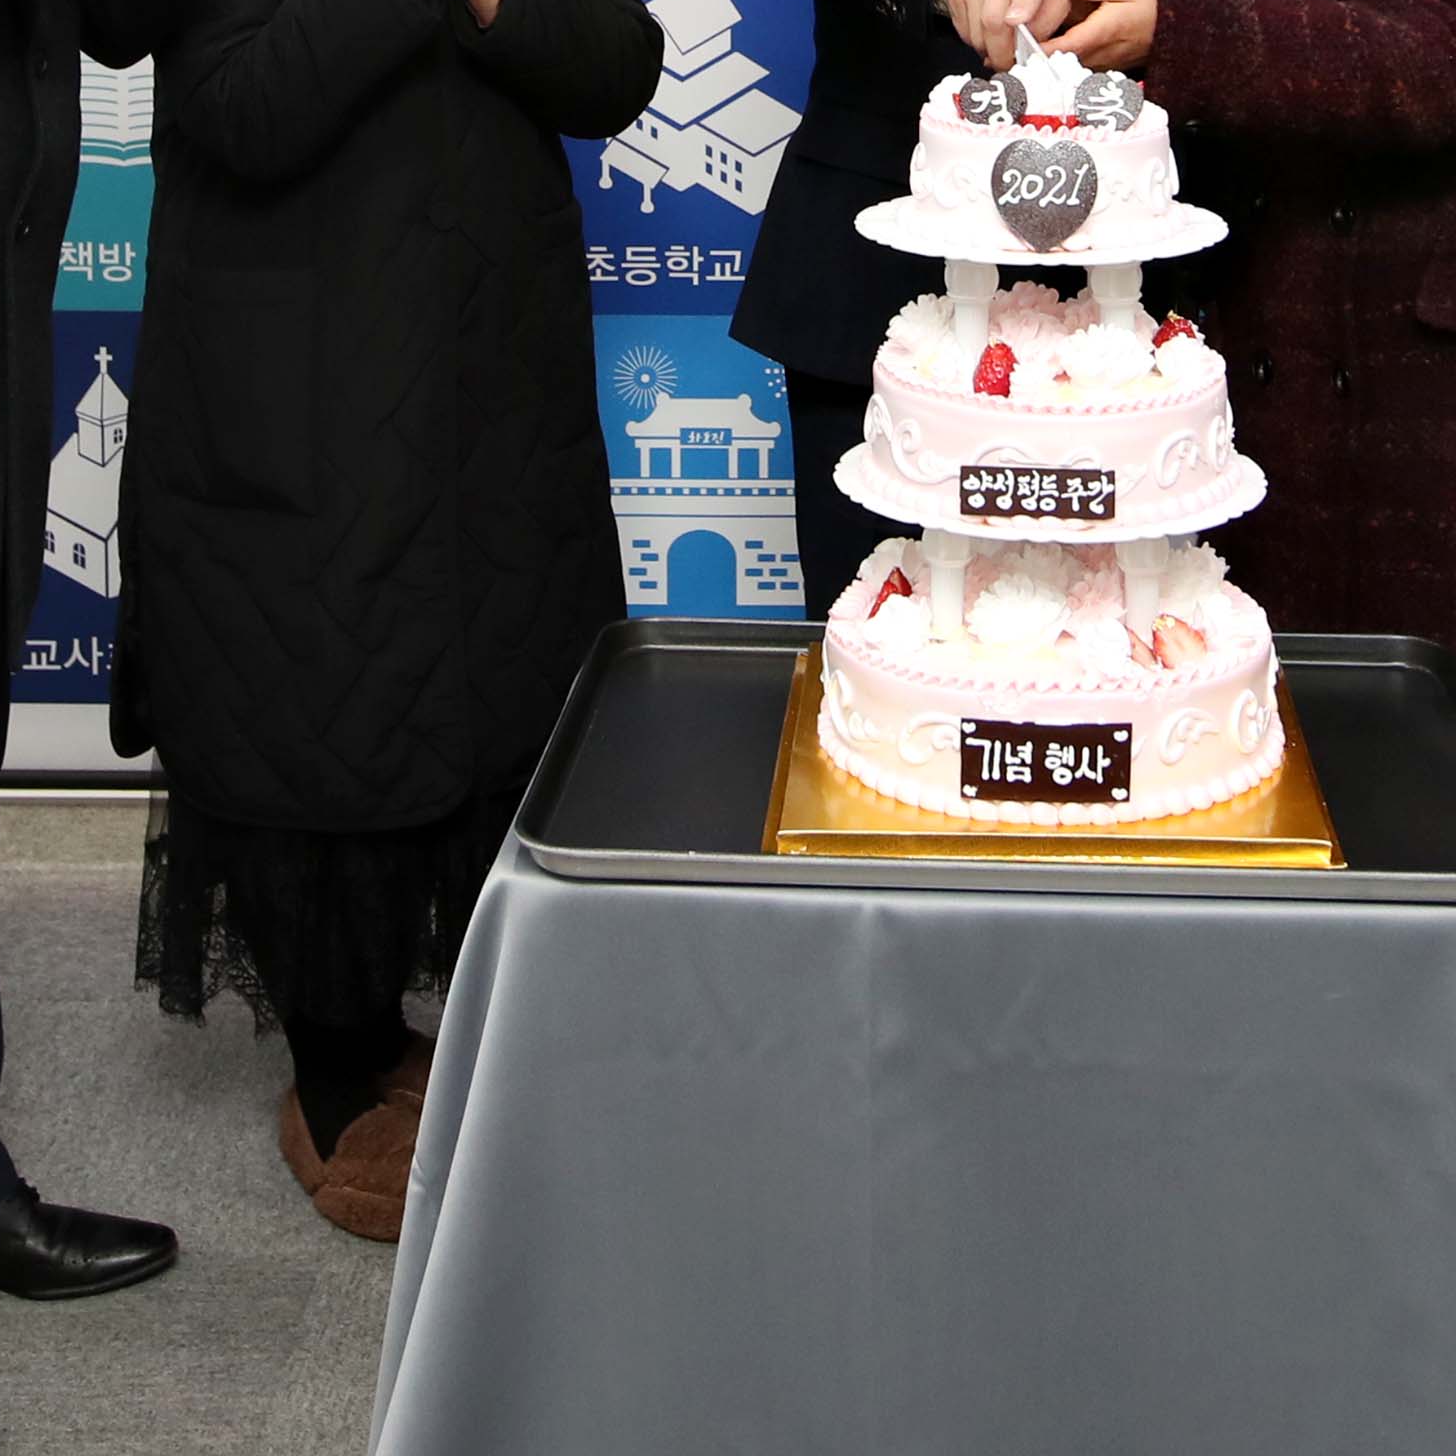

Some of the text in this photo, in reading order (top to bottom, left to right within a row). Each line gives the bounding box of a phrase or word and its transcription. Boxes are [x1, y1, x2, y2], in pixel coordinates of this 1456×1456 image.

[998, 163, 1090, 208] 2021
[59, 241, 137, 282] 책방
[585, 245, 746, 286] 초등학교
[962, 469, 1115, 515] 양성평등 주간
[965, 737, 1112, 786] 기념 행사
